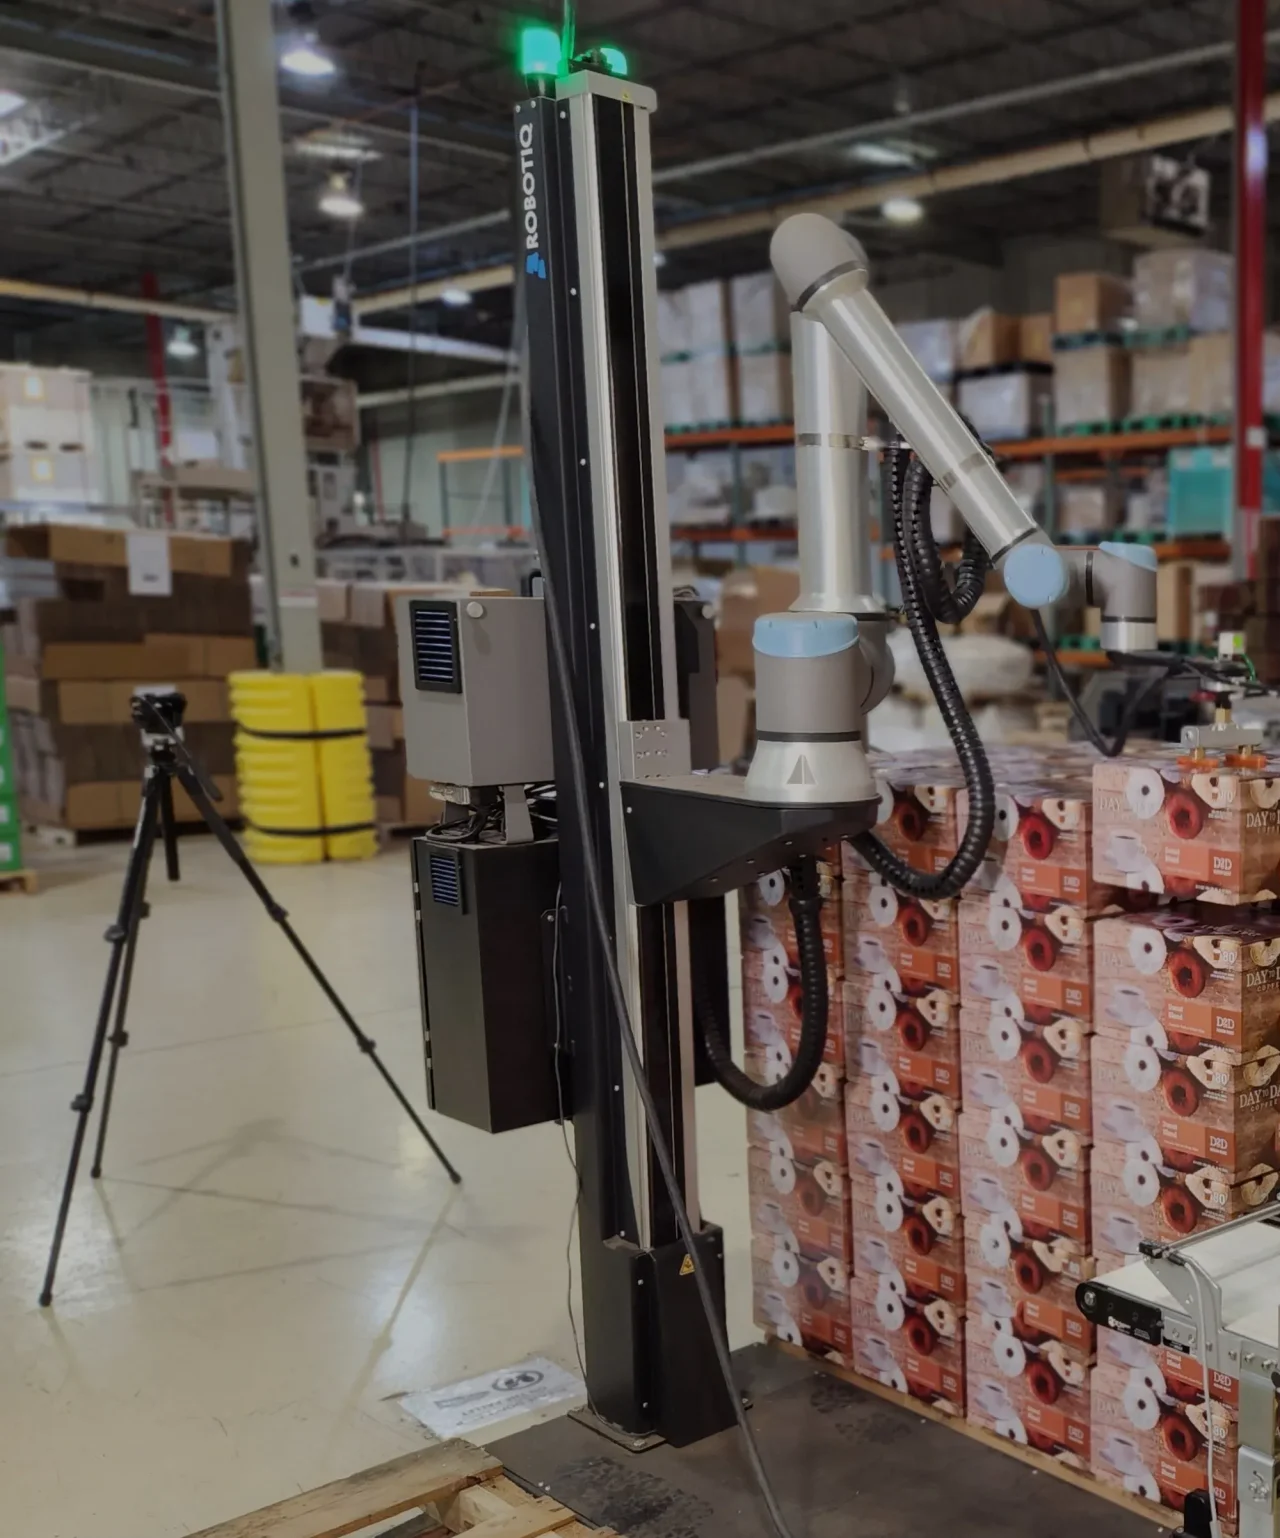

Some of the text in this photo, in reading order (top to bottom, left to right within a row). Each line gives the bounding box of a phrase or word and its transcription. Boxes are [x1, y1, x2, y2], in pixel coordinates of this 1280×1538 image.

[519, 122, 539, 249] ROBOTIQ
[1246, 812, 1269, 829] DAY
[1221, 949, 1235, 963] 80
[1246, 971, 1269, 988] DAY
[1213, 1072, 1227, 1085] 80
[1239, 1089, 1262, 1108] DAY
[1262, 1089, 1269, 1098] TO
[1250, 1098, 1278, 1112] COFFEE
[1212, 1193, 1226, 1206] 80
